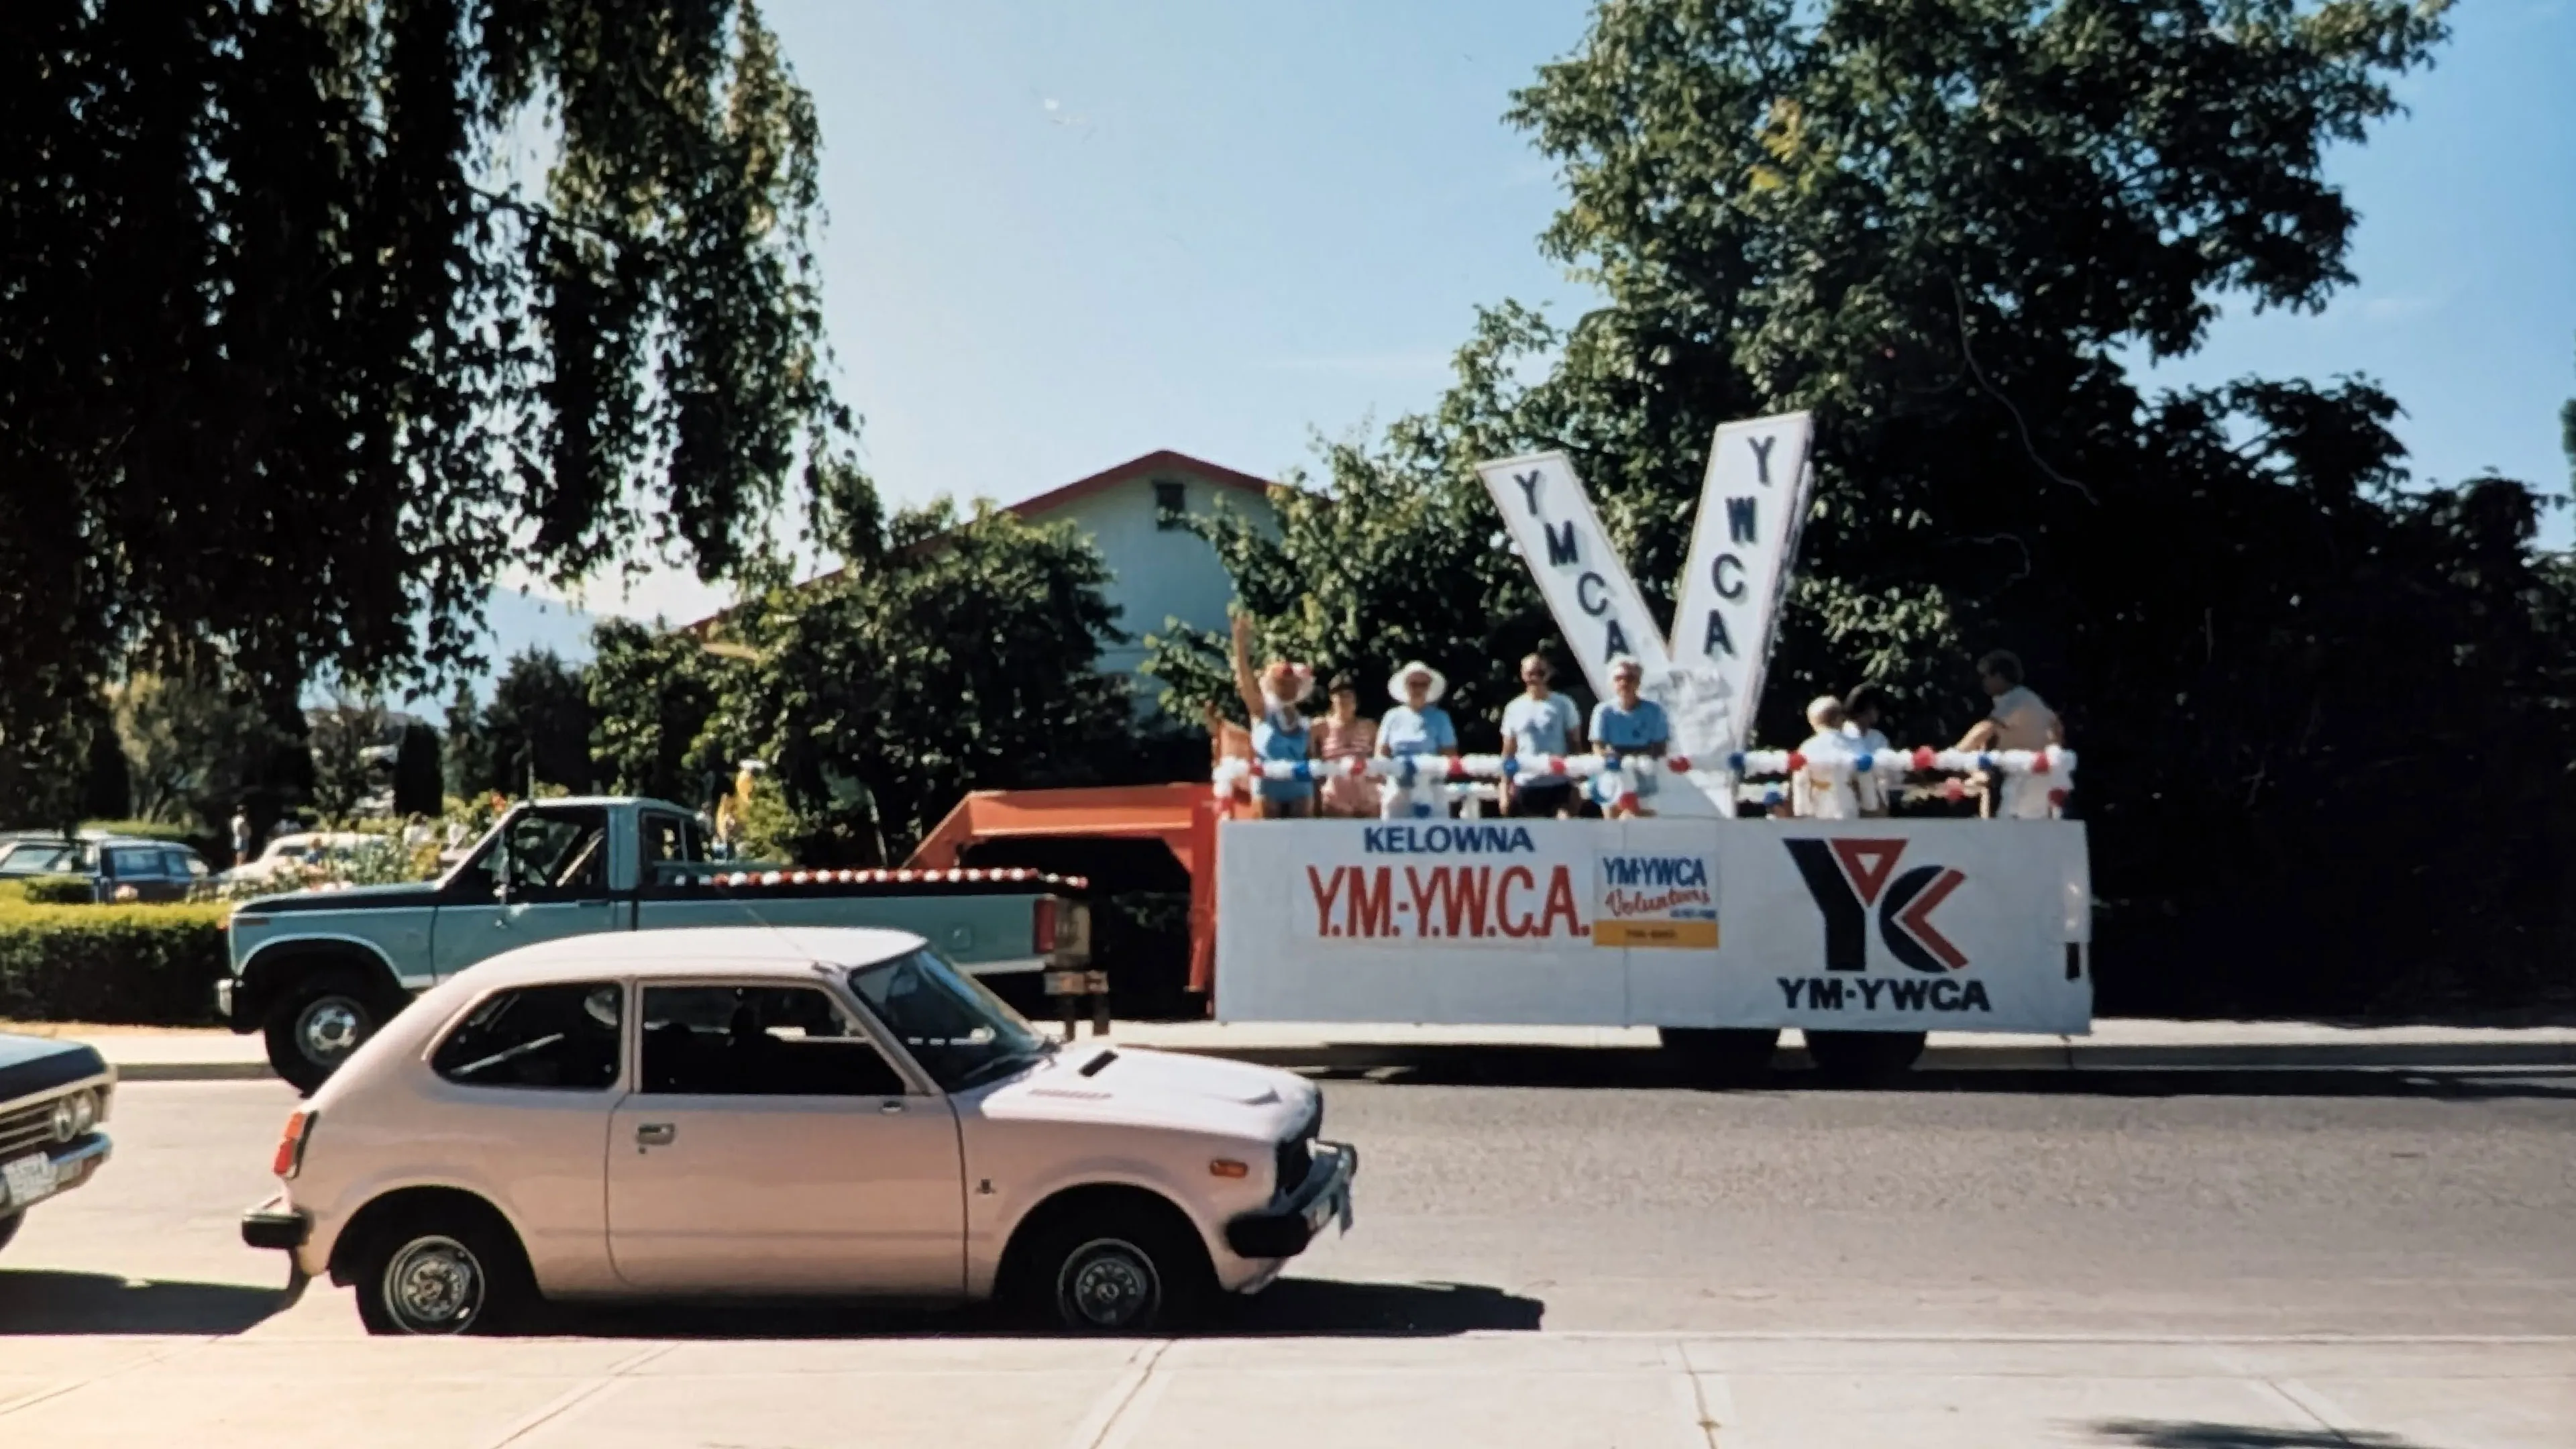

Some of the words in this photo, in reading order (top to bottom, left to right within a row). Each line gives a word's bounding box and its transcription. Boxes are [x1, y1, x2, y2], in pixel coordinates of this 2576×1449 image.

[1513, 470, 1631, 663] YMCA
[1704, 436, 1776, 655] YWCA
[1364, 826, 1535, 853] KELOWNA
